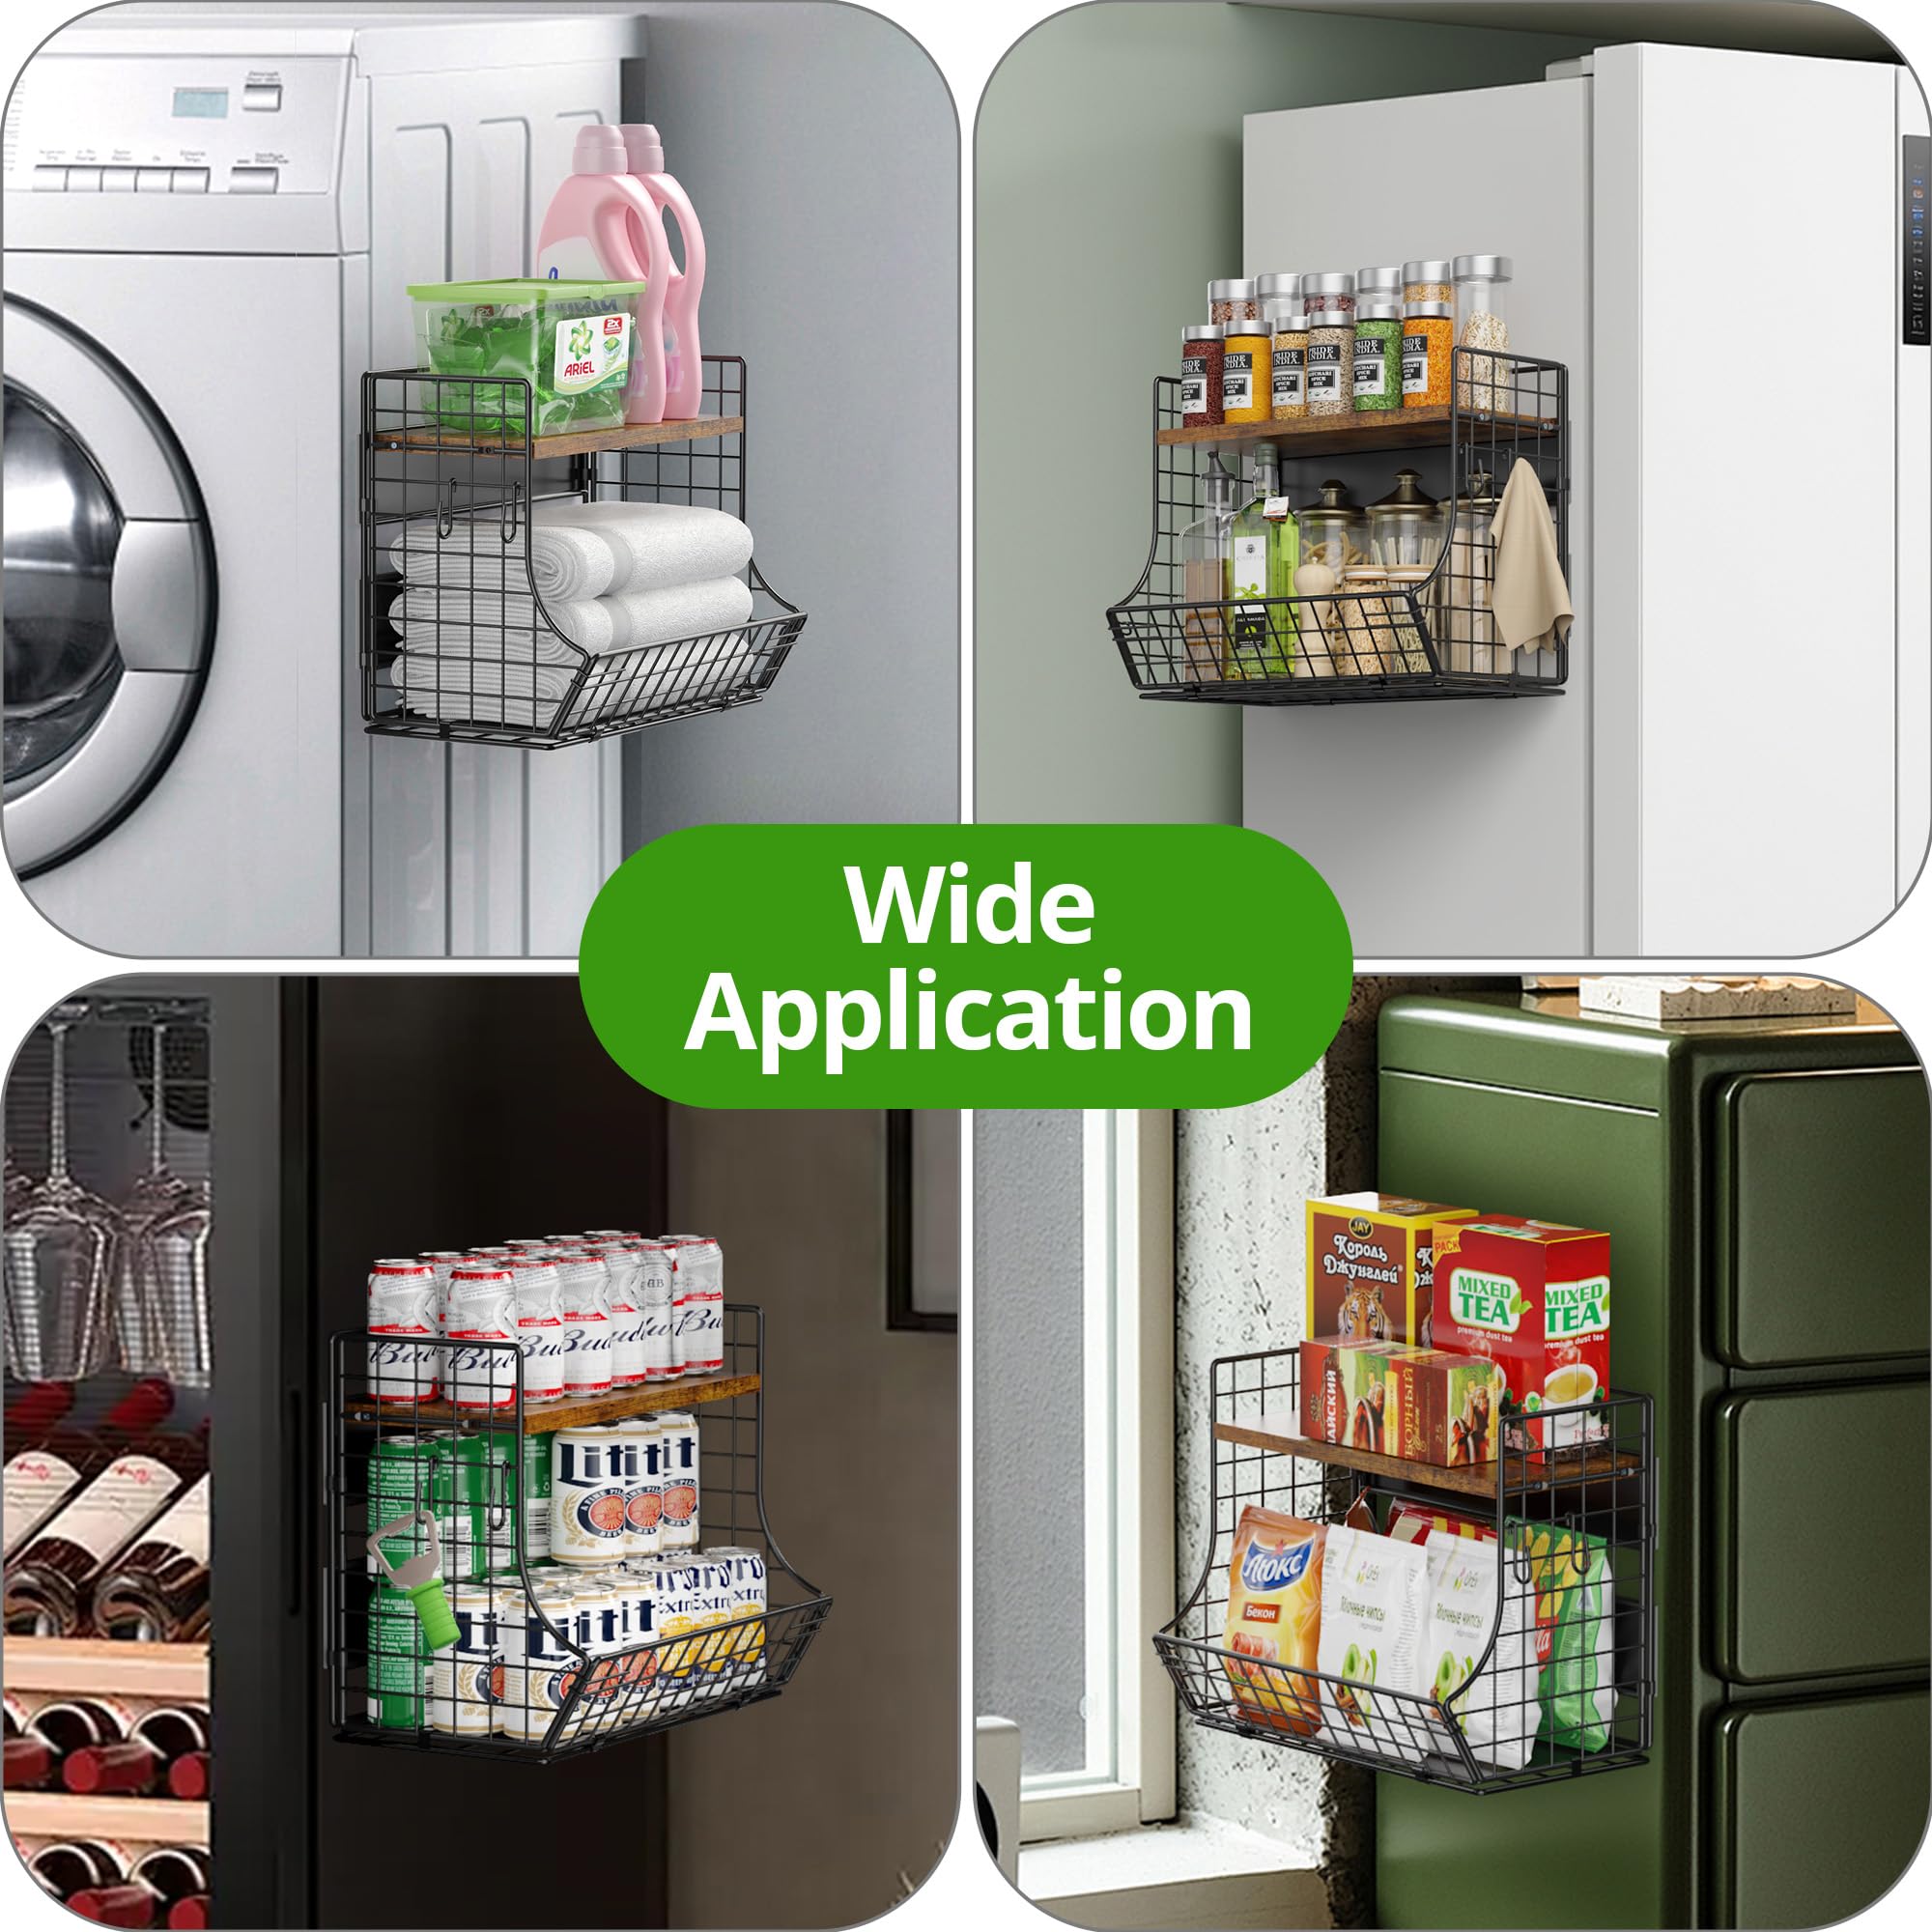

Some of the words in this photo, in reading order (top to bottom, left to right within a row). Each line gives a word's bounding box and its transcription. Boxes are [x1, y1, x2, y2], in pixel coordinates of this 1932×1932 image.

[1351, 1220, 1371, 1234] JAY
[1333, 1234, 1388, 1263] Король
[1435, 1239, 1460, 1253] PACK
[1458, 1275, 1512, 1299] MIXED
[1546, 1283, 1604, 1306] MIXED
[1458, 1293, 1510, 1326] TEA
[1546, 1300, 1603, 1333] TEA
[1457, 1326, 1485, 1338] premium
[1243, 1553, 1303, 1583] Люкс
[1246, 1605, 1276, 1619] Бекон
